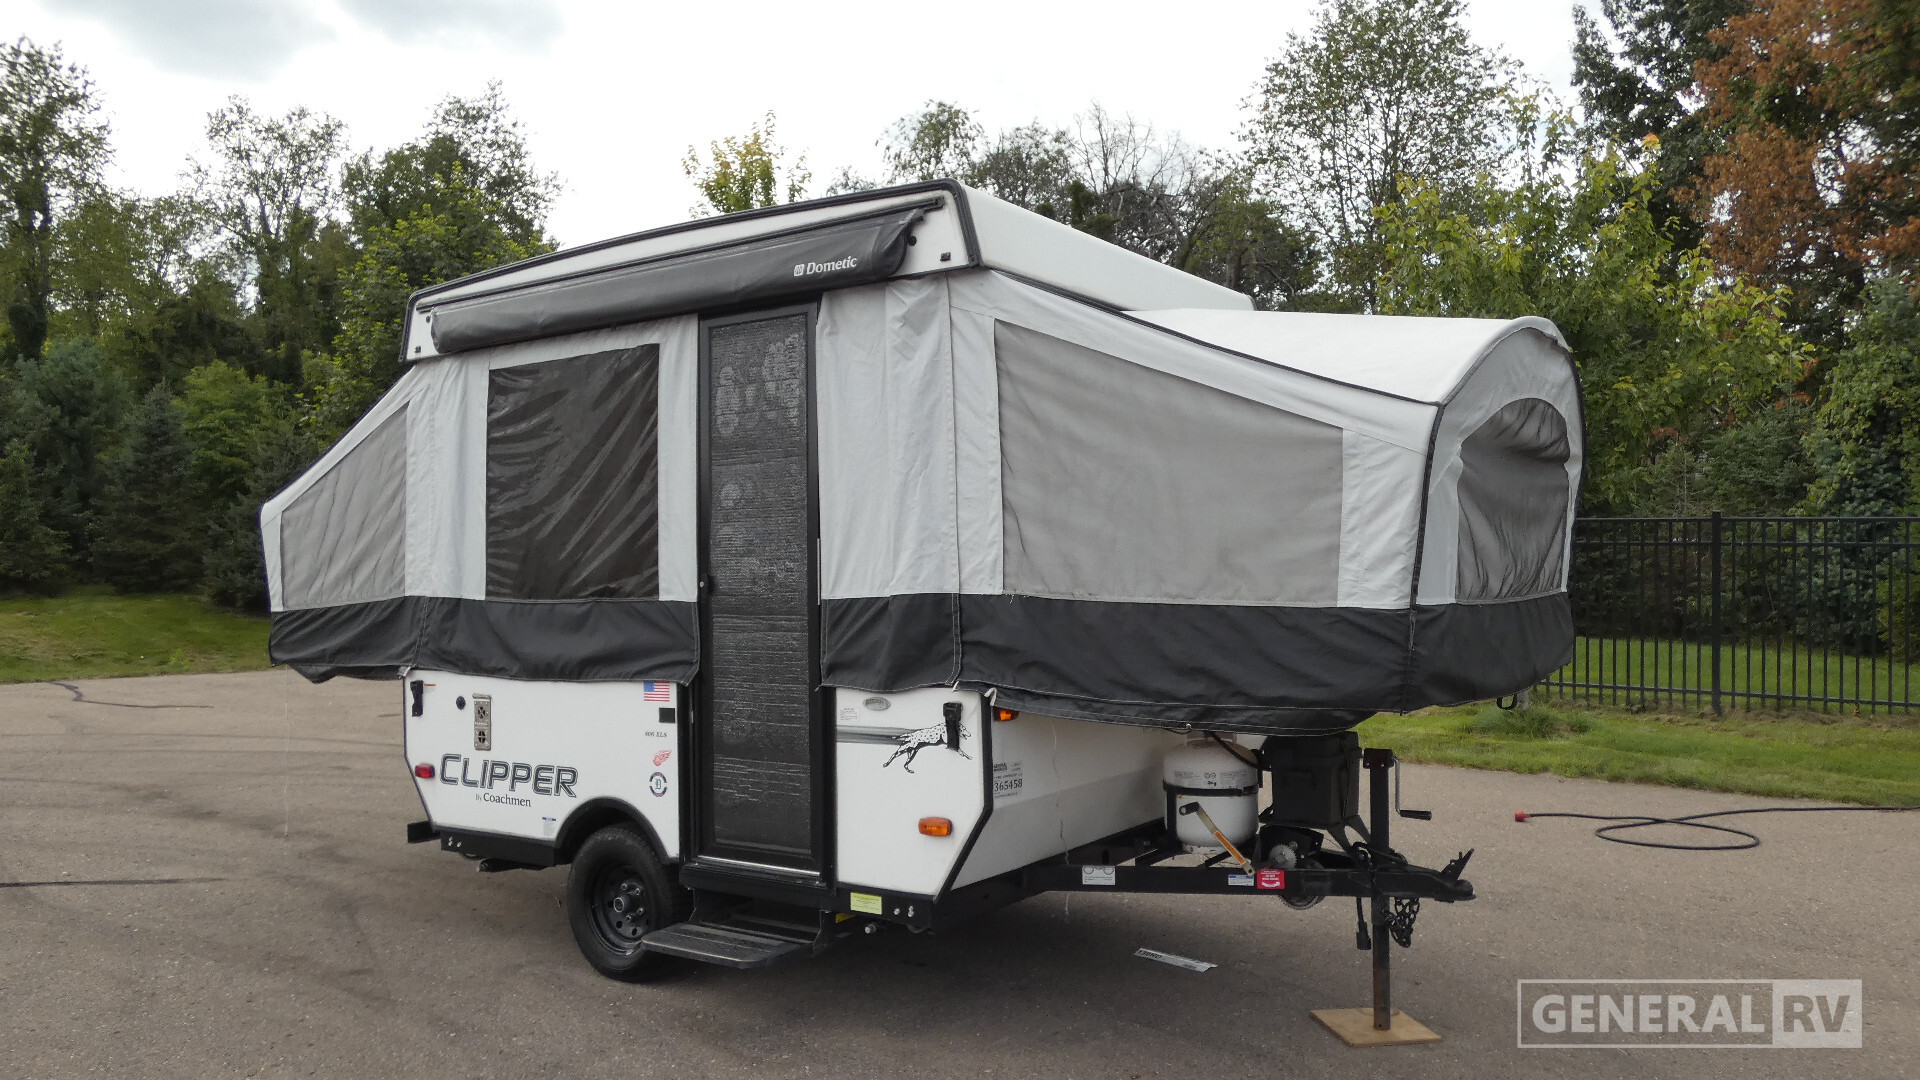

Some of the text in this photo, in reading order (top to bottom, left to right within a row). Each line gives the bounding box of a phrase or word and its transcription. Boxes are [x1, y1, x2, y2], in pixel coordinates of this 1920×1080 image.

[806, 256, 857, 274] Dometic
[440, 753, 578, 798] CLIPPER
[483, 792, 531, 807] Coachmen
